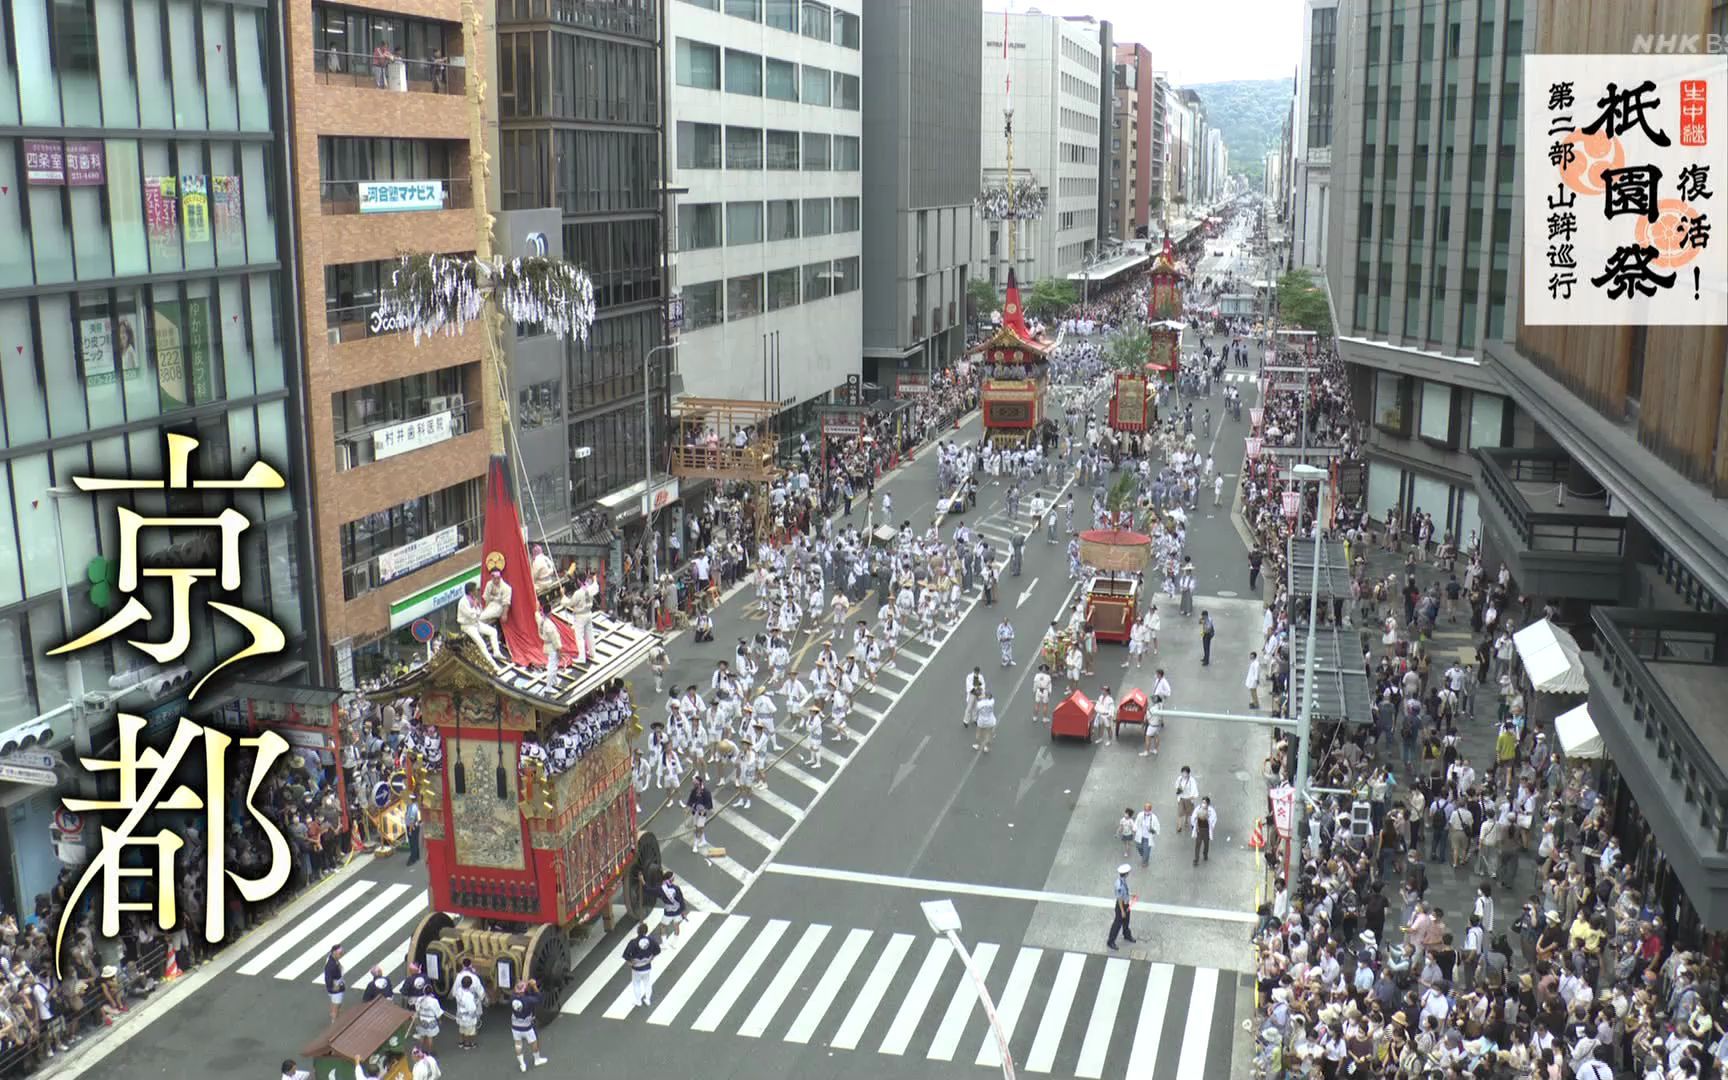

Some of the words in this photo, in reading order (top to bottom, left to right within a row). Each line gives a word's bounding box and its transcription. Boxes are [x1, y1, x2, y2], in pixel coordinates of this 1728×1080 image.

[26, 152, 101, 170] 四条室町歯科
[367, 185, 435, 202] 河合塾マナビス
[189, 302, 207, 399] ゆかり皮フ科
[385, 416, 444, 447] 村井歯科医院
[432, 586, 464, 607] FamilyMart
